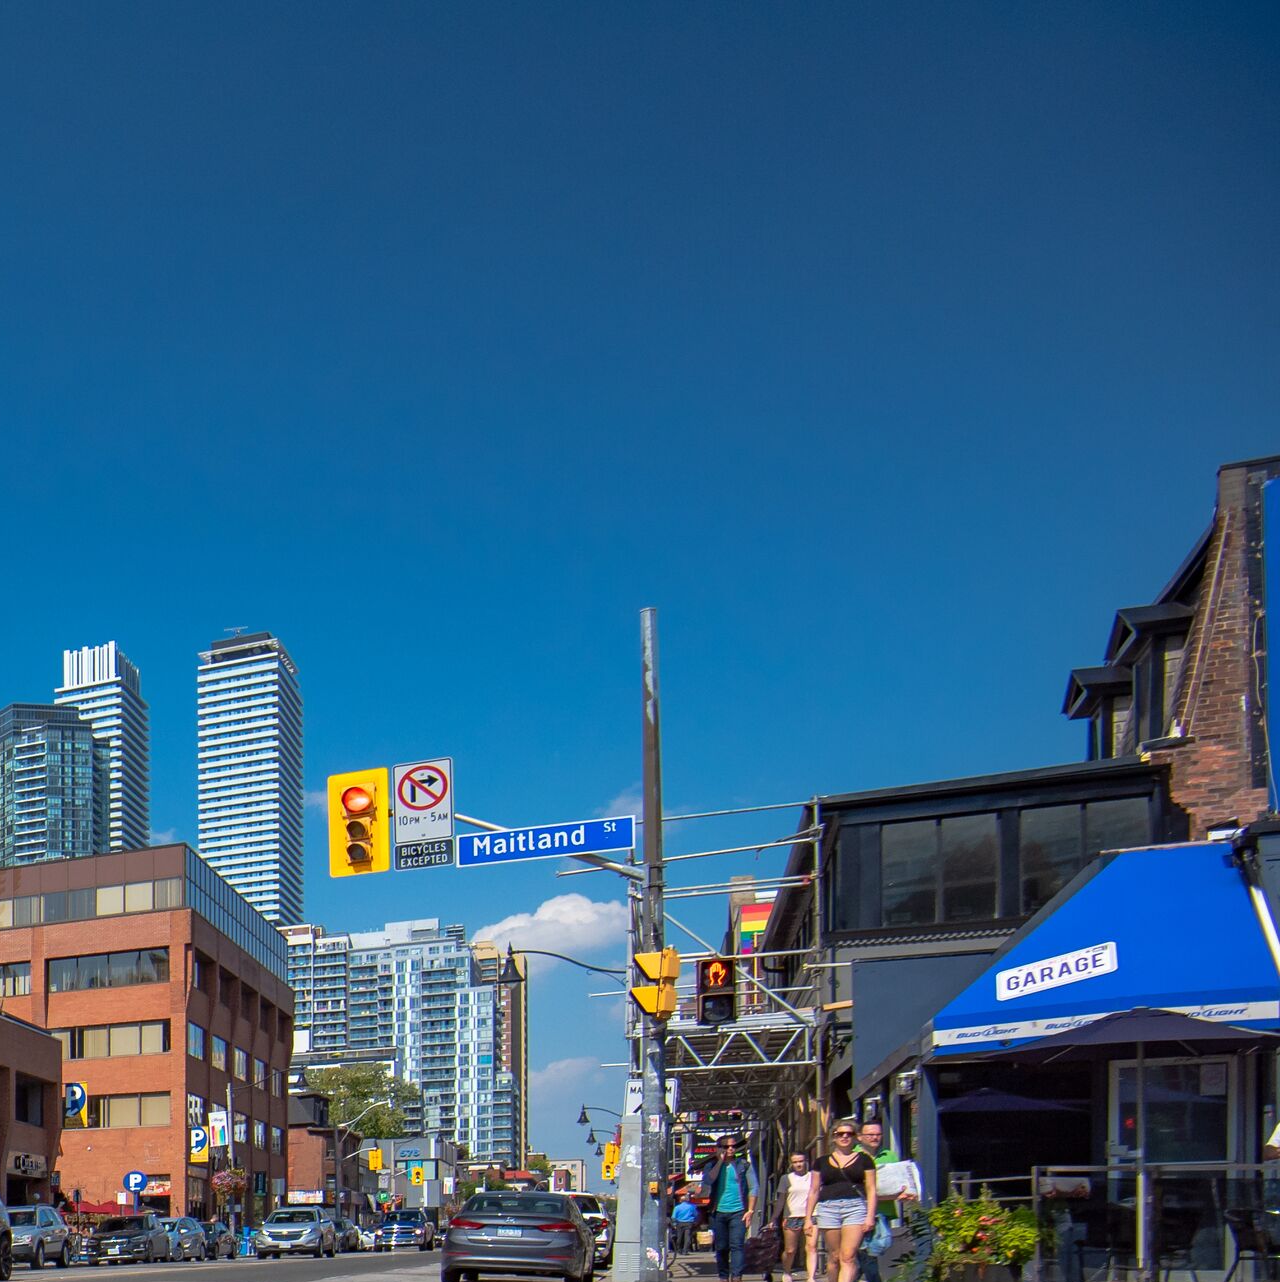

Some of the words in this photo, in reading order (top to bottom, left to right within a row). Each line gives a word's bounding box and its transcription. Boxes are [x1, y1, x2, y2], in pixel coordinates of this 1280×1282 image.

[473, 824, 585, 857] Maitland
[603, 821, 617, 833] St
[401, 842, 447, 857] BICYCLES
[400, 854, 448, 868] EXCEPTED
[1006, 952, 1105, 991] GARAGE
[985, 1027, 1020, 1037] LIGHT
[191, 1129, 204, 1147] P
[129, 1173, 142, 1187] P
